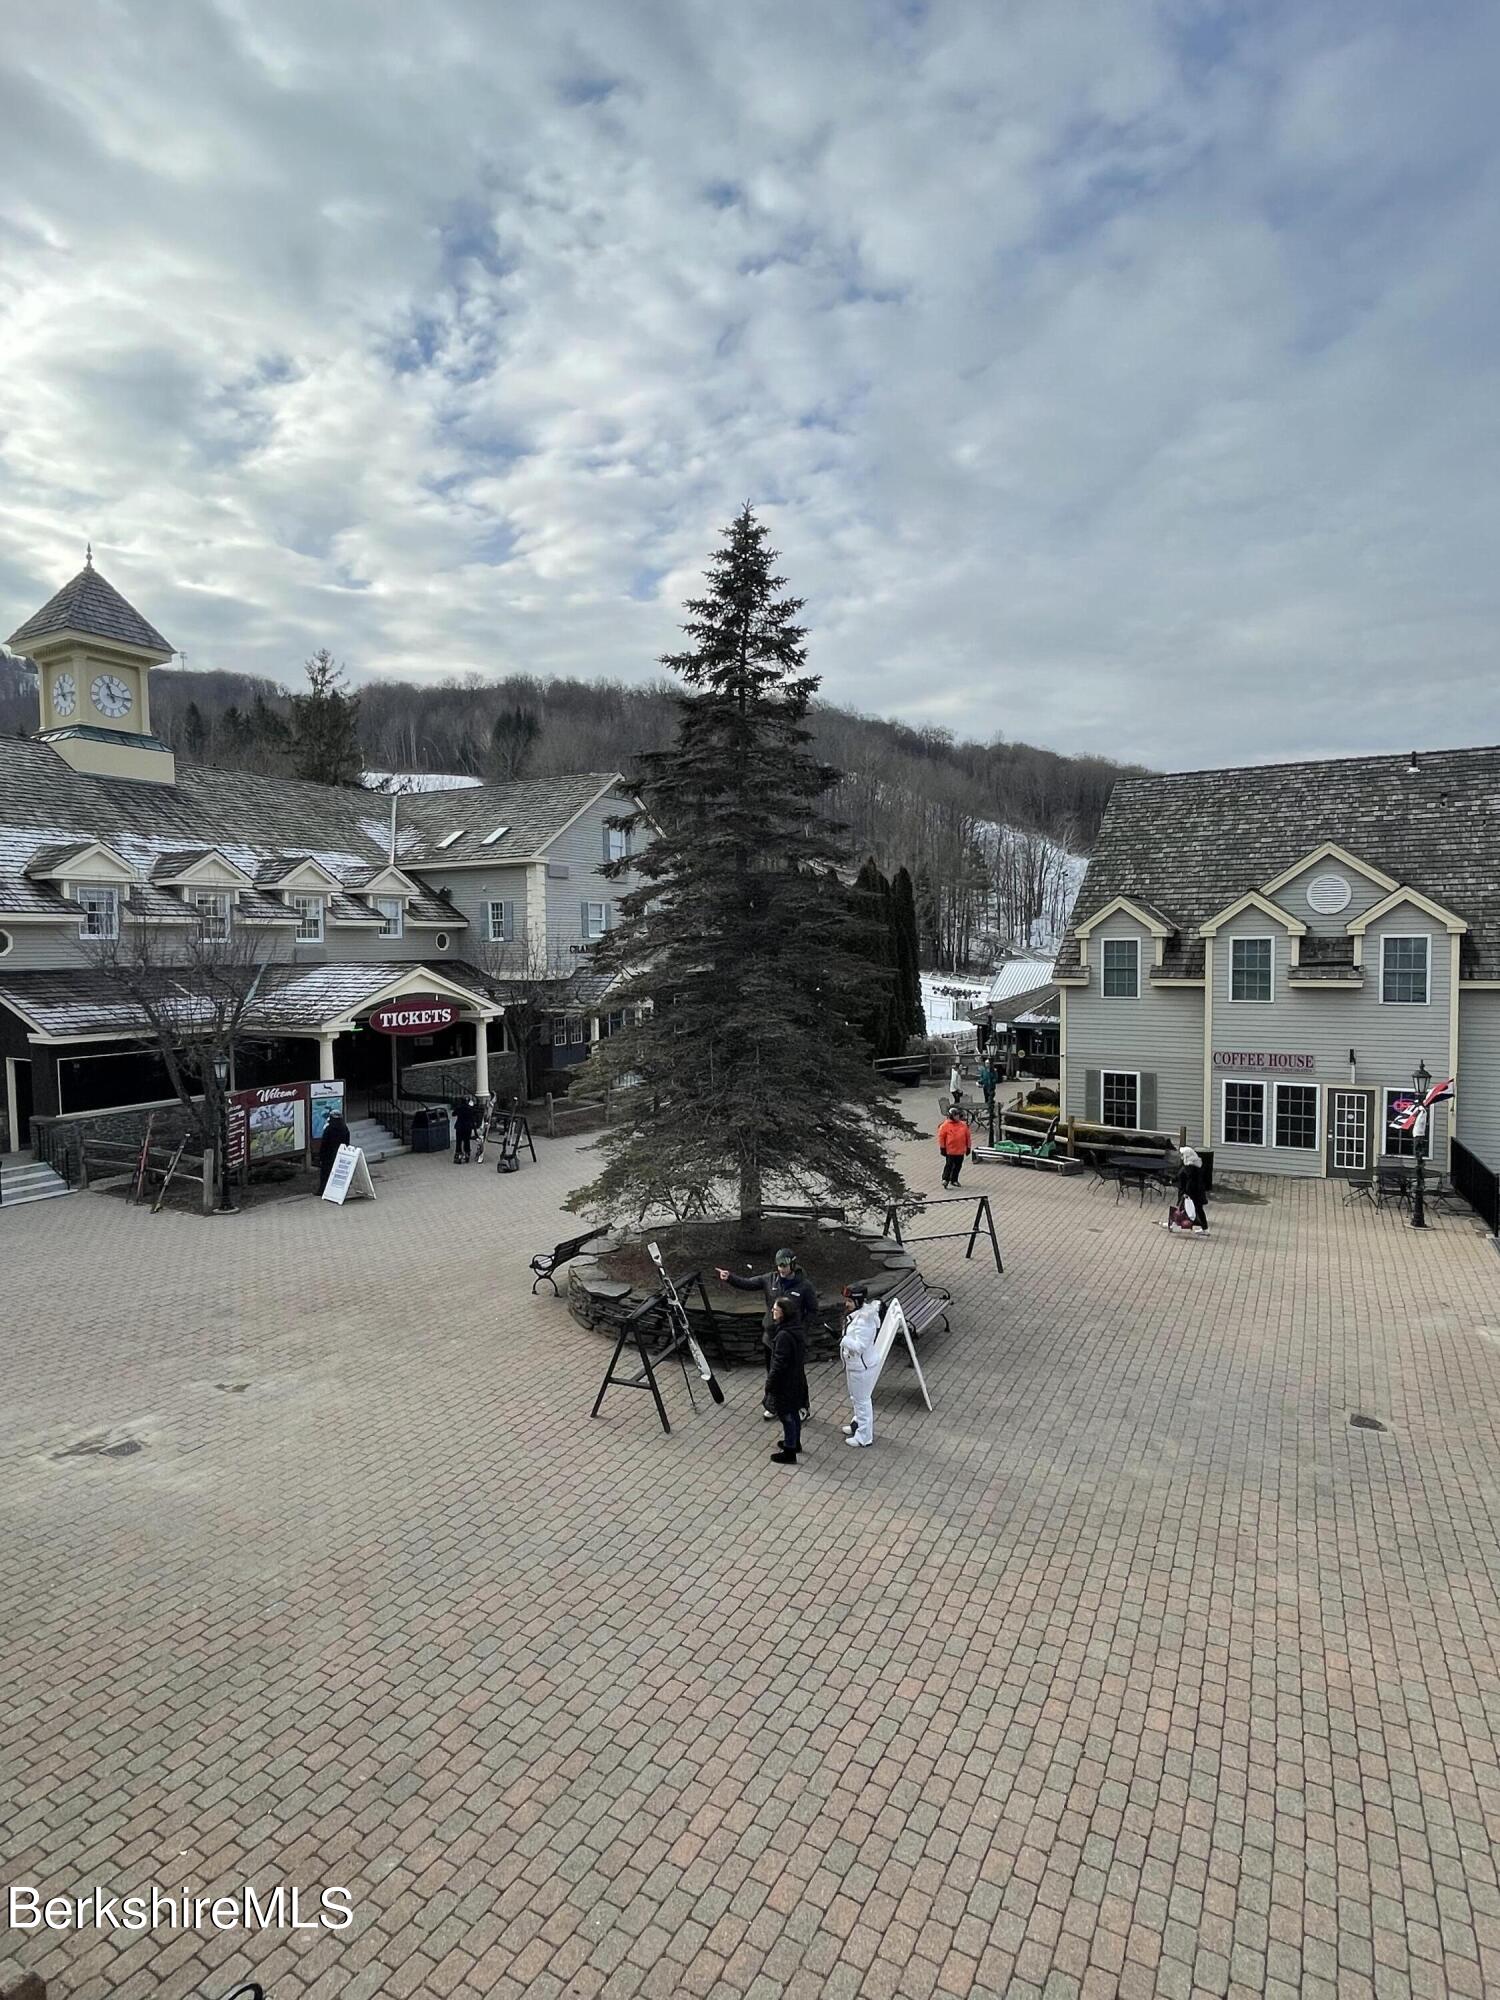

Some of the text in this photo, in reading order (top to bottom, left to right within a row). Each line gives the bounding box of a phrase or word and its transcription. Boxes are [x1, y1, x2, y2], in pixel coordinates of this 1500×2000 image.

[380, 1008, 452, 1028] TICKETS
[1213, 1052, 1314, 1068] COFFEE HOUSE
[256, 1087, 298, 1102] Welcome
